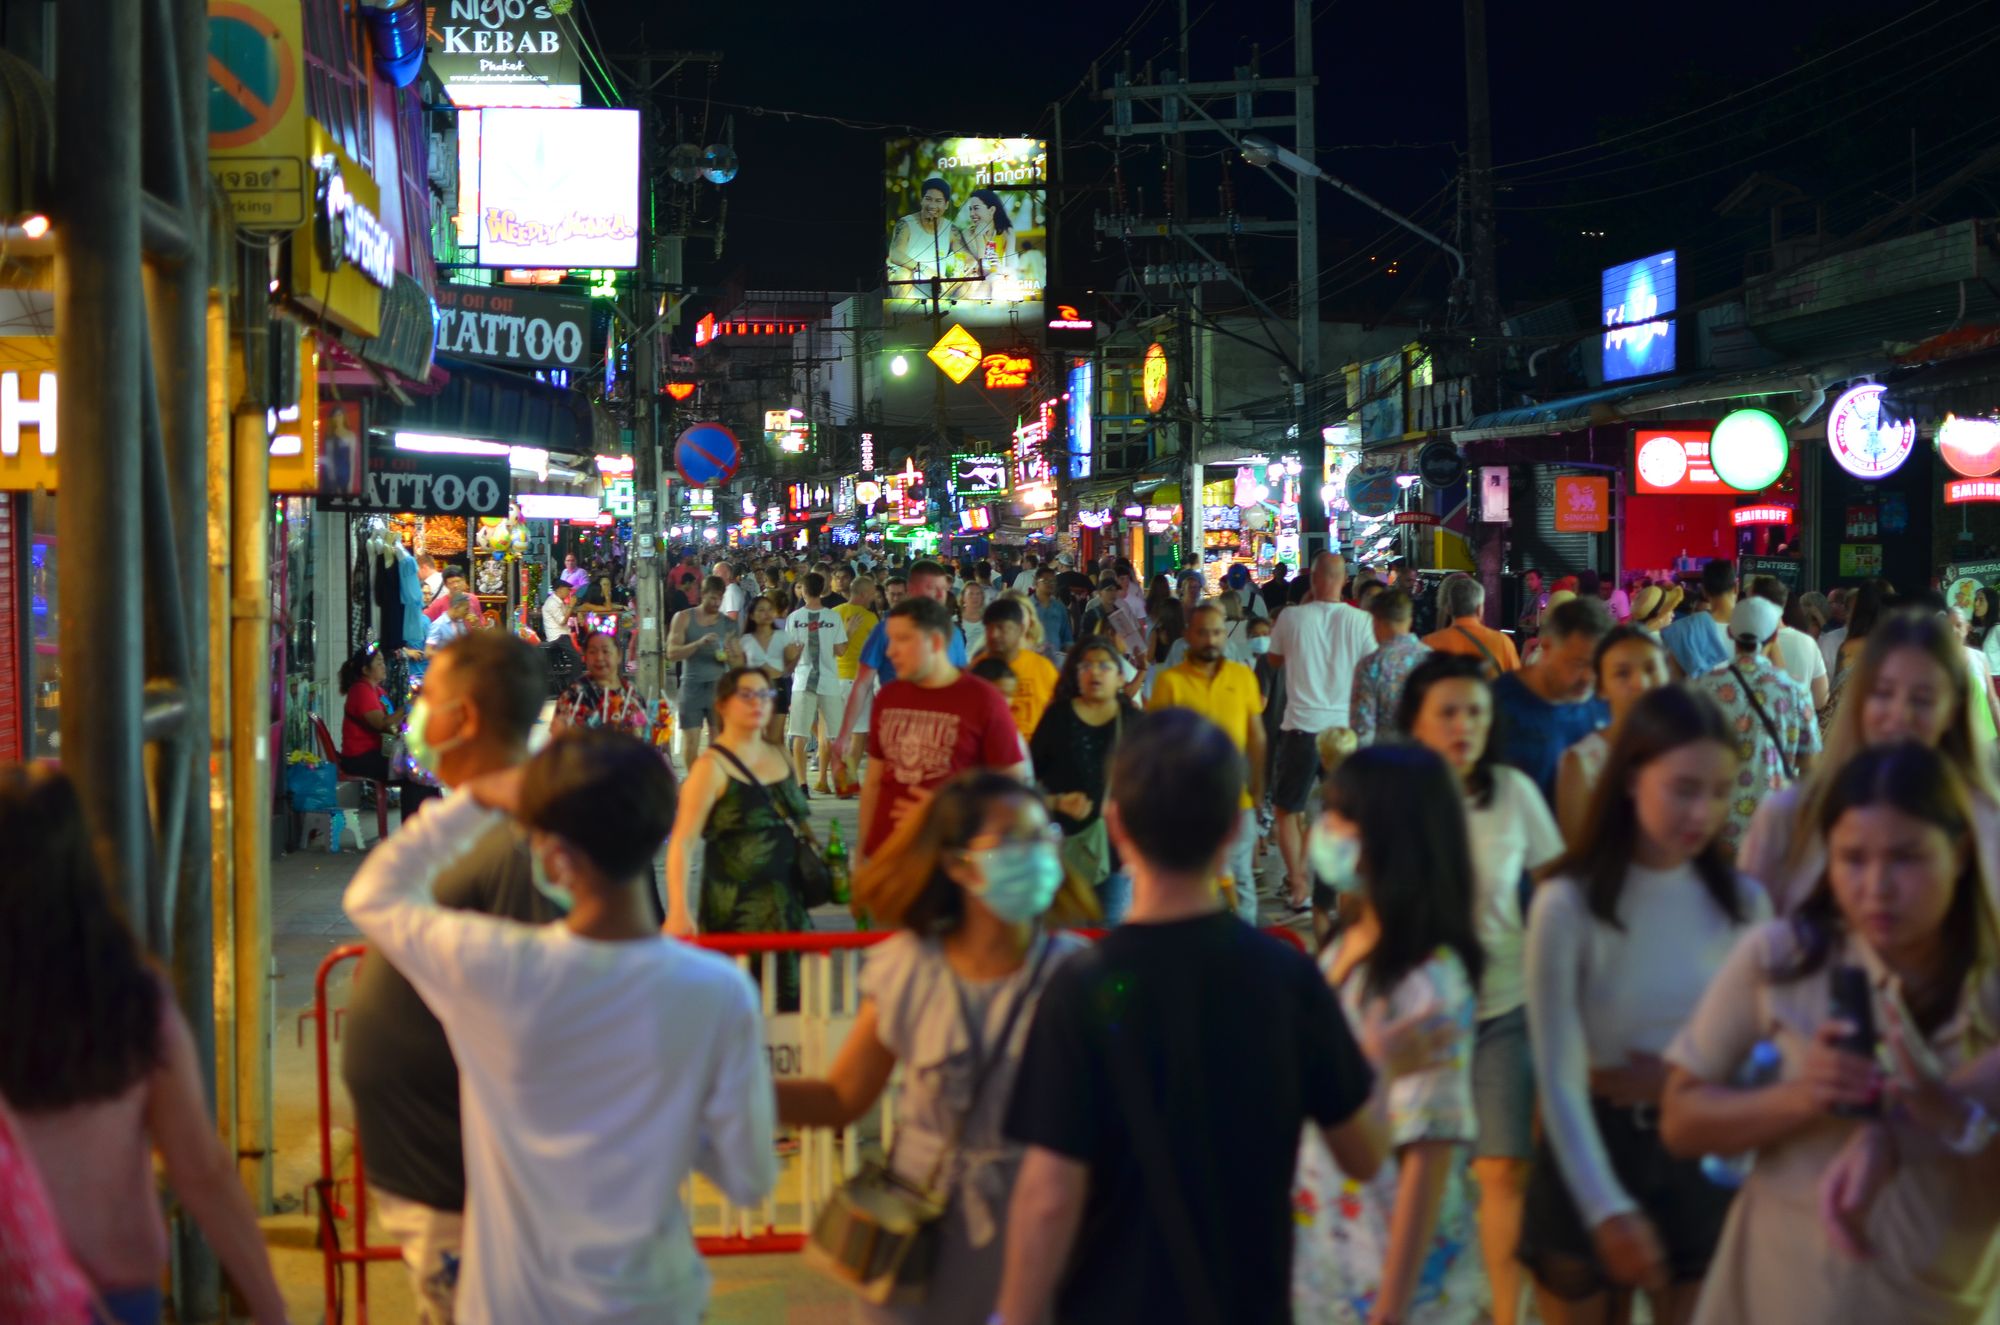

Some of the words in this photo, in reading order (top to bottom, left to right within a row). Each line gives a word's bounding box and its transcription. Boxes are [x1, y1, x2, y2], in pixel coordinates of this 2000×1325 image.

[442, 26, 560, 54] KEBAB
[436, 308, 583, 364] TATTOO
[1563, 513, 1600, 522] SINGHA
[1734, 509, 1788, 523] SMIRNOFF
